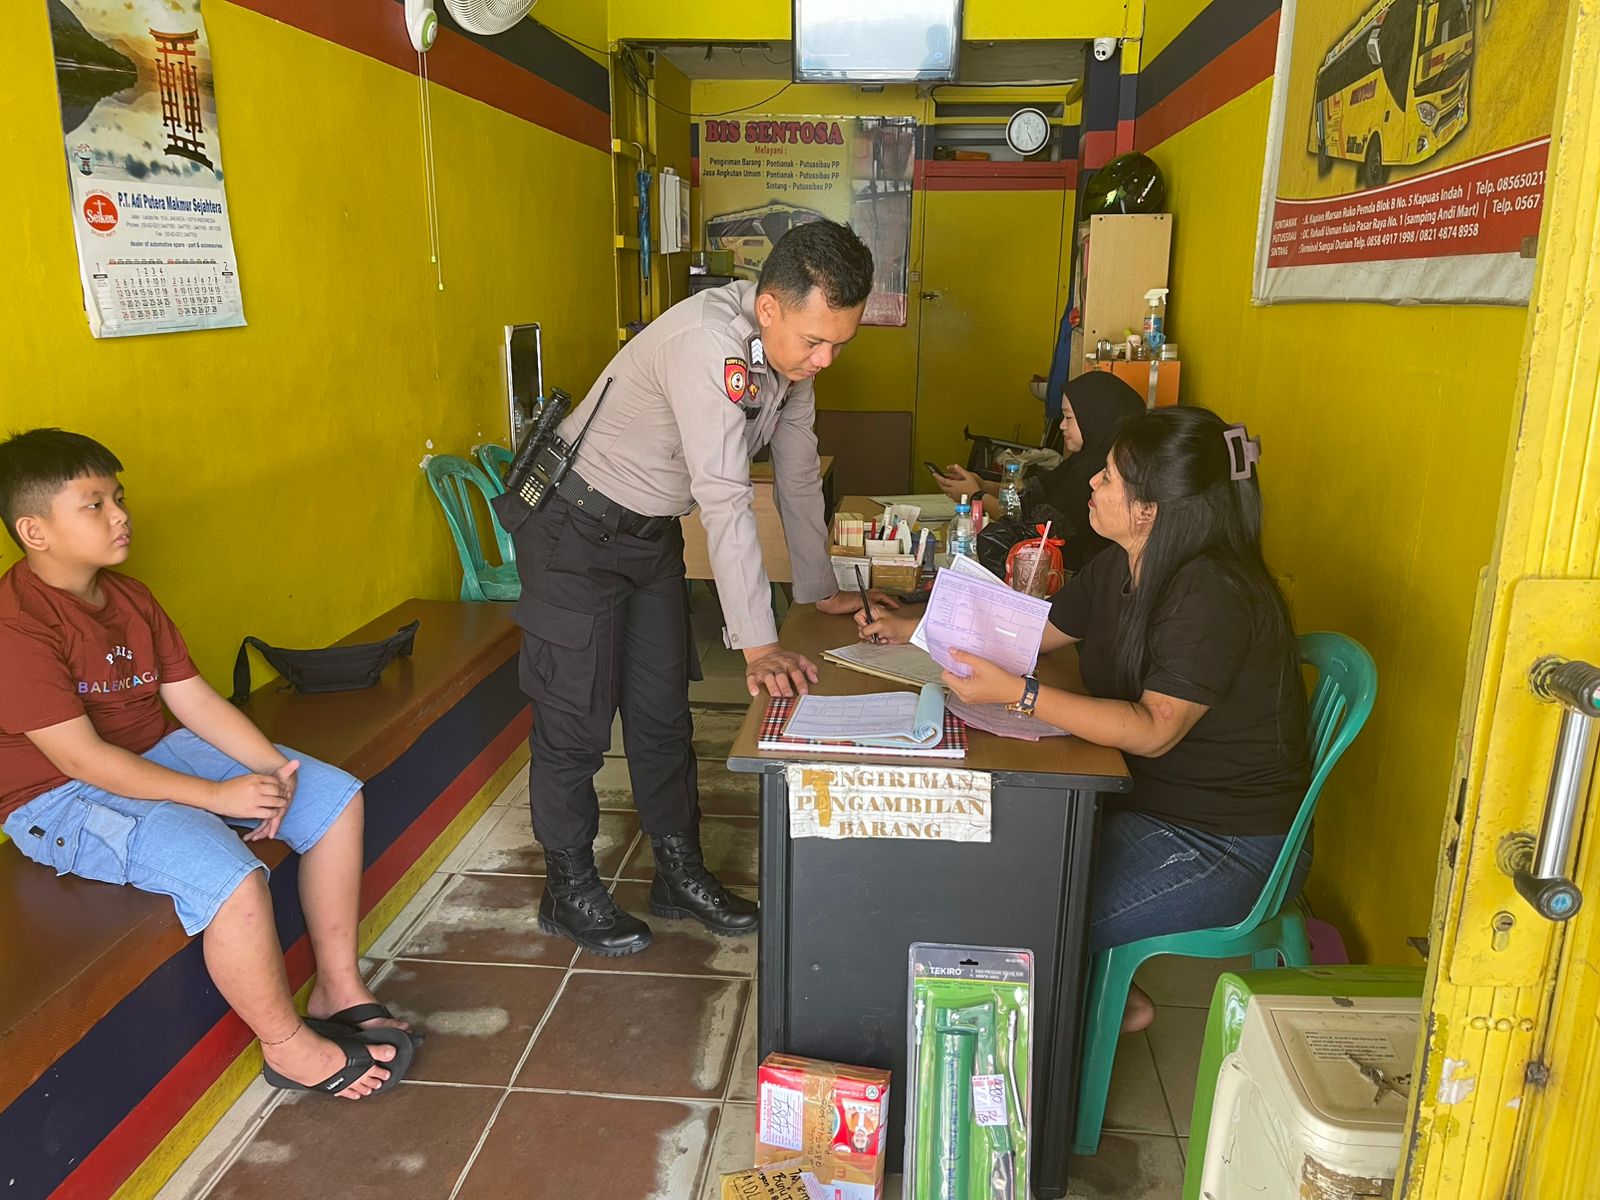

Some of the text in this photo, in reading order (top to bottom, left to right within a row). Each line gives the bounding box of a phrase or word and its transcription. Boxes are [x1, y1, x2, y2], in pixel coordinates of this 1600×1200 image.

[705, 120, 844, 145] BIS SENTOSA
[755, 145, 783, 156] Melayani
[710, 158, 740, 167] Pengiriman
[742, 158, 761, 167] Barang
[766, 160, 794, 168] Pontianak
[832, 160, 840, 168] PP
[716, 169, 742, 178] Angkutan
[766, 170, 794, 178] Pontianak
[832, 172, 840, 180] PP
[766, 182, 788, 192] Sintang
[824, 182, 833, 190] PP
[1356, 202, 1376, 216] Pemda
[1376, 199, 1390, 212] Blok
[1390, 198, 1396, 210] B
[1396, 196, 1407, 208] No.
[1408, 194, 1413, 206] 5
[1414, 192, 1440, 207] Kapuas
[1440, 184, 1462, 201] Indah
[1476, 180, 1495, 197] Telp.
[1497, 170, 1546, 192] 08565021
[118, 192, 222, 216] P.T. Adi Putera Makmur Sejahtera
[1356, 220, 1372, 232] Pasar
[1372, 218, 1386, 232] Raya
[1387, 216, 1398, 227] No.
[1404, 210, 1437, 228] (samping
[1437, 205, 1456, 221] Andi
[1456, 202, 1480, 218] Mart)
[1492, 198, 1512, 216] Telp.
[1515, 194, 1540, 210] 0567
[1354, 236, 1366, 250] Telp.
[1382, 232, 1398, 245] 4917
[1399, 230, 1414, 244] 1998
[1420, 228, 1436, 241] 0821
[1438, 226, 1457, 240] 4874
[1458, 223, 1479, 238] 8958
[106, 646, 134, 665] PRIS
[803, 770, 975, 791] NGIRIMAN
[795, 795, 986, 816] PNGAMBILAN
[838, 821, 942, 838] BARANG
[929, 966, 962, 976] TEKIRO
